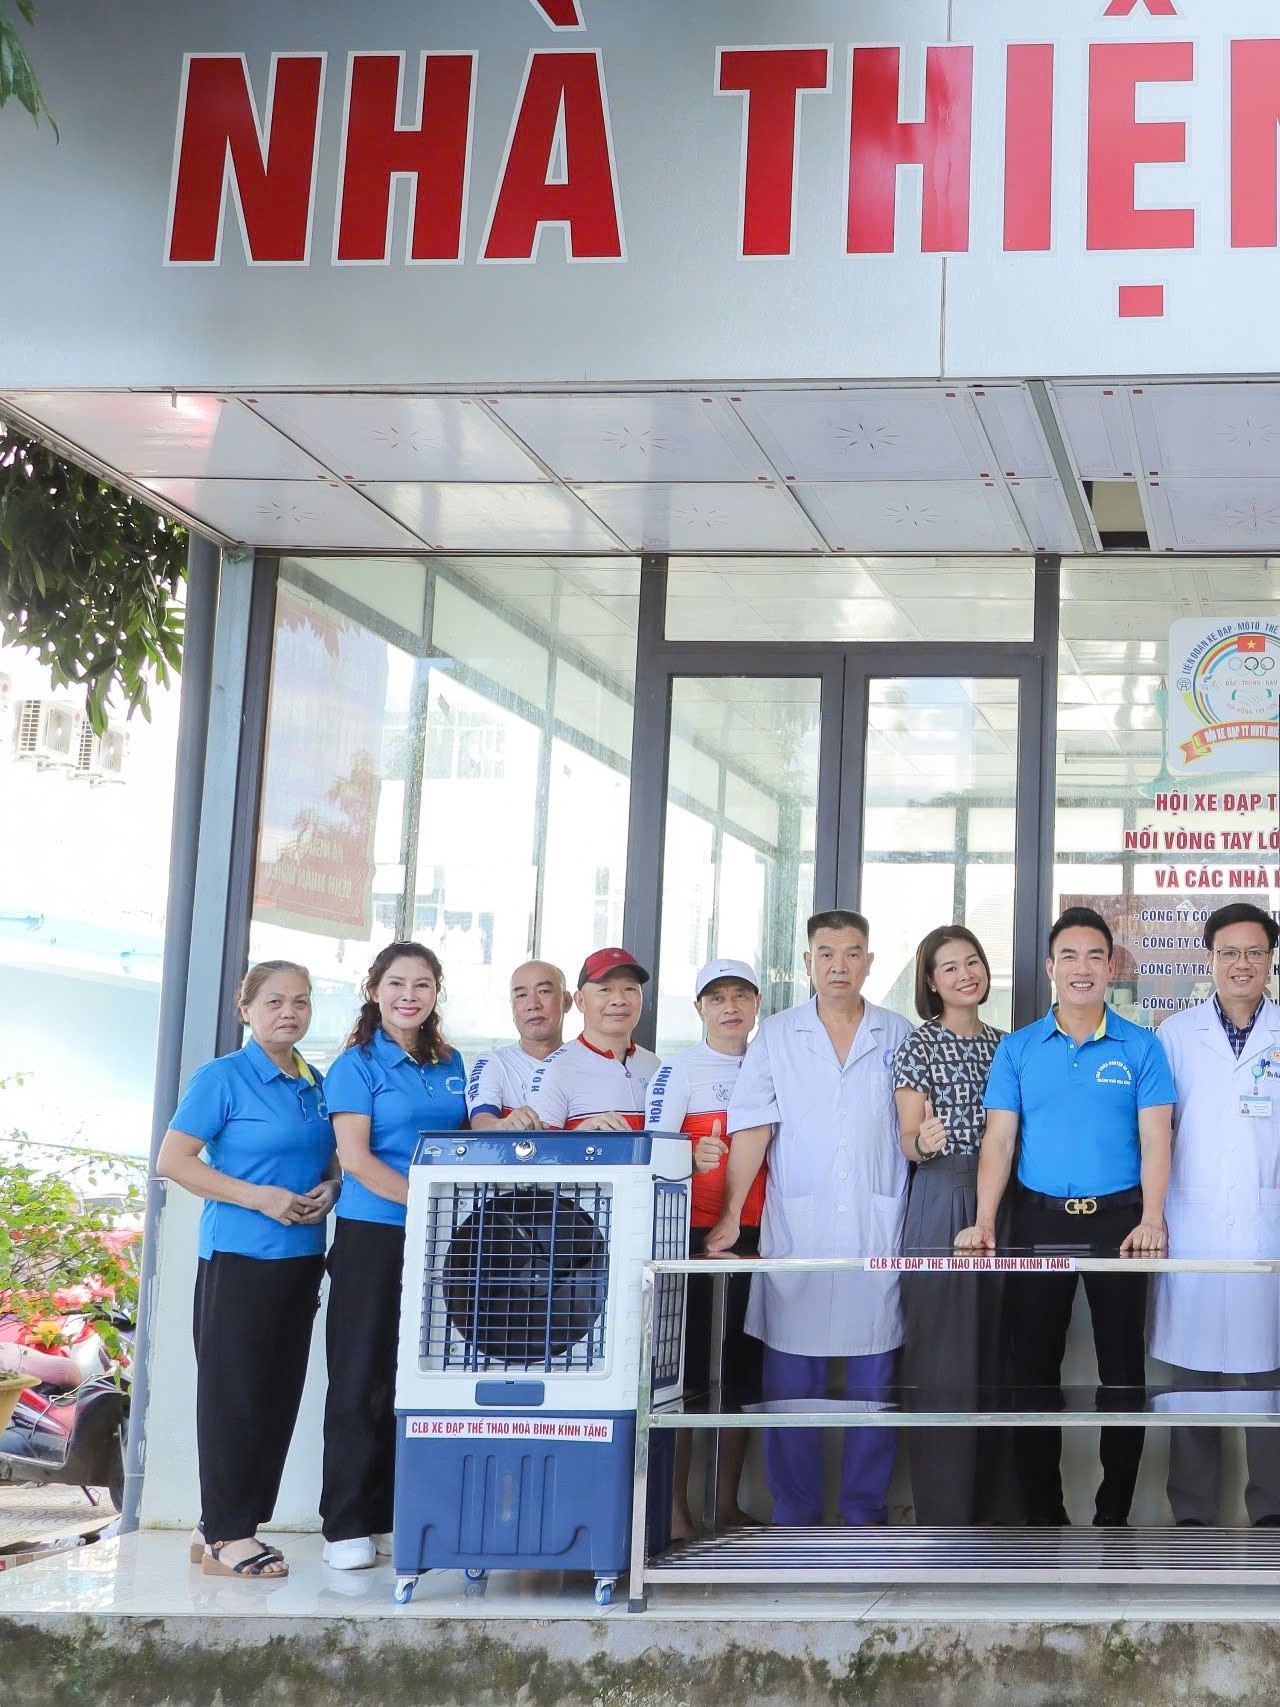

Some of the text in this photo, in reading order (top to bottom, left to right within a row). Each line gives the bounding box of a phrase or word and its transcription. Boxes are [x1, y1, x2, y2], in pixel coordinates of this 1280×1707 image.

[166, 0, 627, 265] NHÀ
[1156, 789, 1188, 816] HỘI
[1194, 793, 1218, 812] XE
[1223, 793, 1262, 816] ĐẠP
[1125, 824, 1158, 850] NỐI
[1164, 826, 1216, 850] VÒNG
[1221, 831, 1253, 850] TAY
[1155, 865, 1180, 888] VÀ
[1185, 865, 1224, 888] CÁC
[1229, 865, 1269, 888] NHÀ
[1141, 907, 1173, 922] CÔNG
[1177, 910, 1190, 922] TY
[1143, 935, 1174, 949] CÔNG
[1178, 937, 1190, 949] TY
[1176, 963, 1188, 975] TY
[1142, 996, 1174, 1010] CÔNG
[1178, 998, 1190, 1010] TY
[870, 1257, 888, 1270] CLB
[890, 1258, 902, 1270] XE
[946, 1258, 970, 1270] THAO
[412, 1421, 429, 1434] CLB
[432, 1422, 443, 1434] XE
[446, 1422, 465, 1437] ĐẠP
[467, 1417, 485, 1434] THỂ
[486, 1422, 510, 1435] THAO
[533, 1421, 556, 1436] BÌNH
[558, 1422, 580, 1437] KÍNH
[583, 1423, 608, 1440] TẶNG
